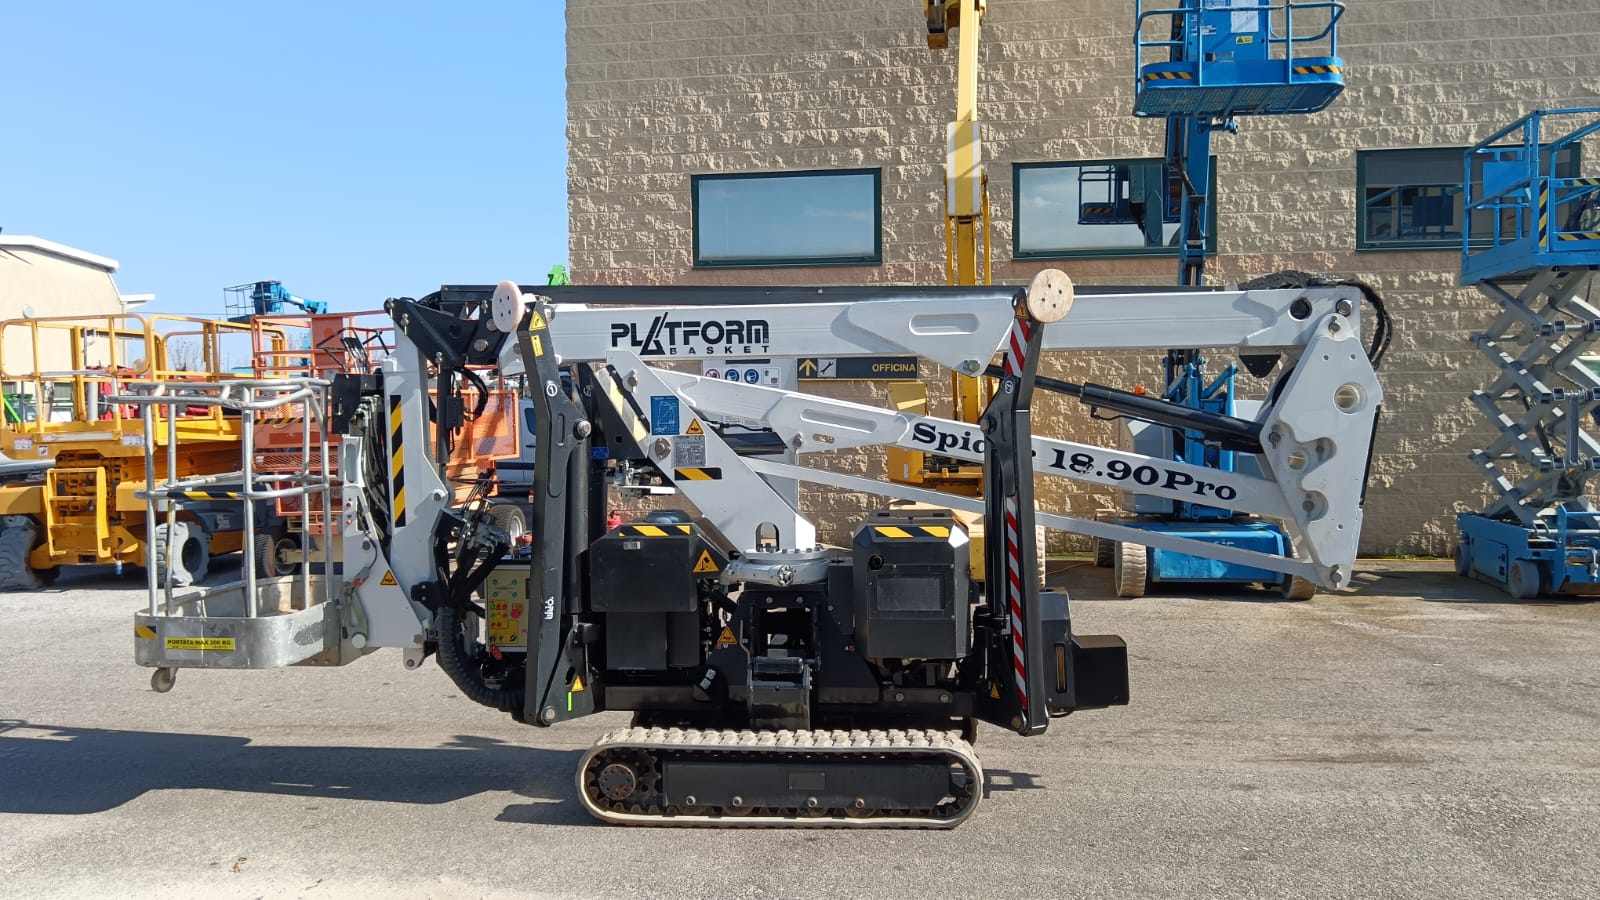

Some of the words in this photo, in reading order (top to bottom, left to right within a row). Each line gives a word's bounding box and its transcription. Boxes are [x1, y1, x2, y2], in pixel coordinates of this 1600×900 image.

[611, 312, 769, 355] PLATFORM
[670, 345, 769, 355] BASKET
[872, 363, 916, 372] OFFICINA
